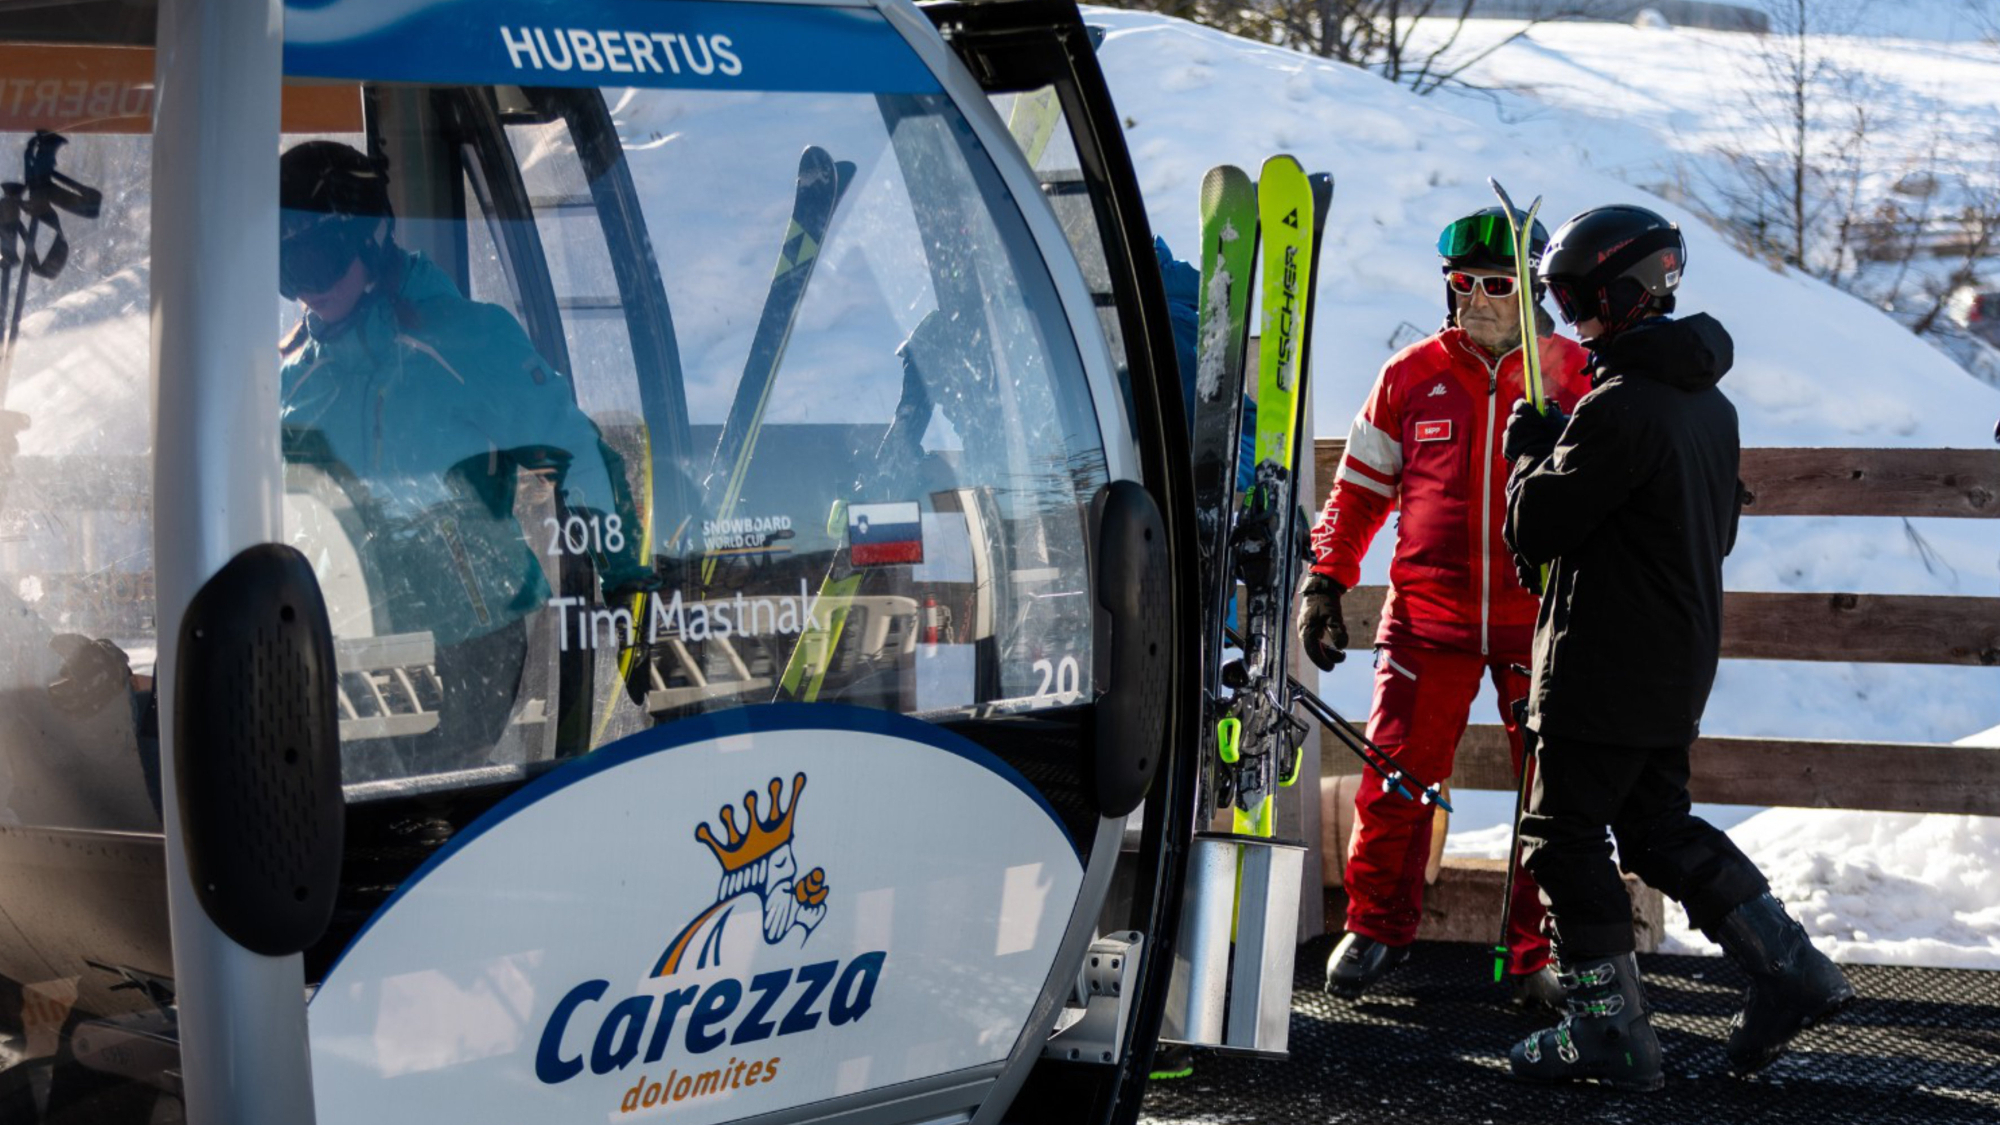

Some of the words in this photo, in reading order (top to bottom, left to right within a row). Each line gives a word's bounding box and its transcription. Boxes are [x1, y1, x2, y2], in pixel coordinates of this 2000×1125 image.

[500, 25, 743, 76] HUBERTUS
[1528, 257, 1540, 269] OC
[1276, 245, 1298, 393] FISCHER
[543, 513, 625, 556] 2018
[702, 515, 791, 536] SNOWBOARD
[704, 535, 744, 550] WORLD
[745, 534, 766, 548] CUP
[549, 596, 633, 651] Tim
[650, 578, 821, 645] Mastnak
[1032, 655, 1080, 709] 20
[535, 951, 887, 1085] Carezza
[621, 1057, 781, 1113] dolomites
